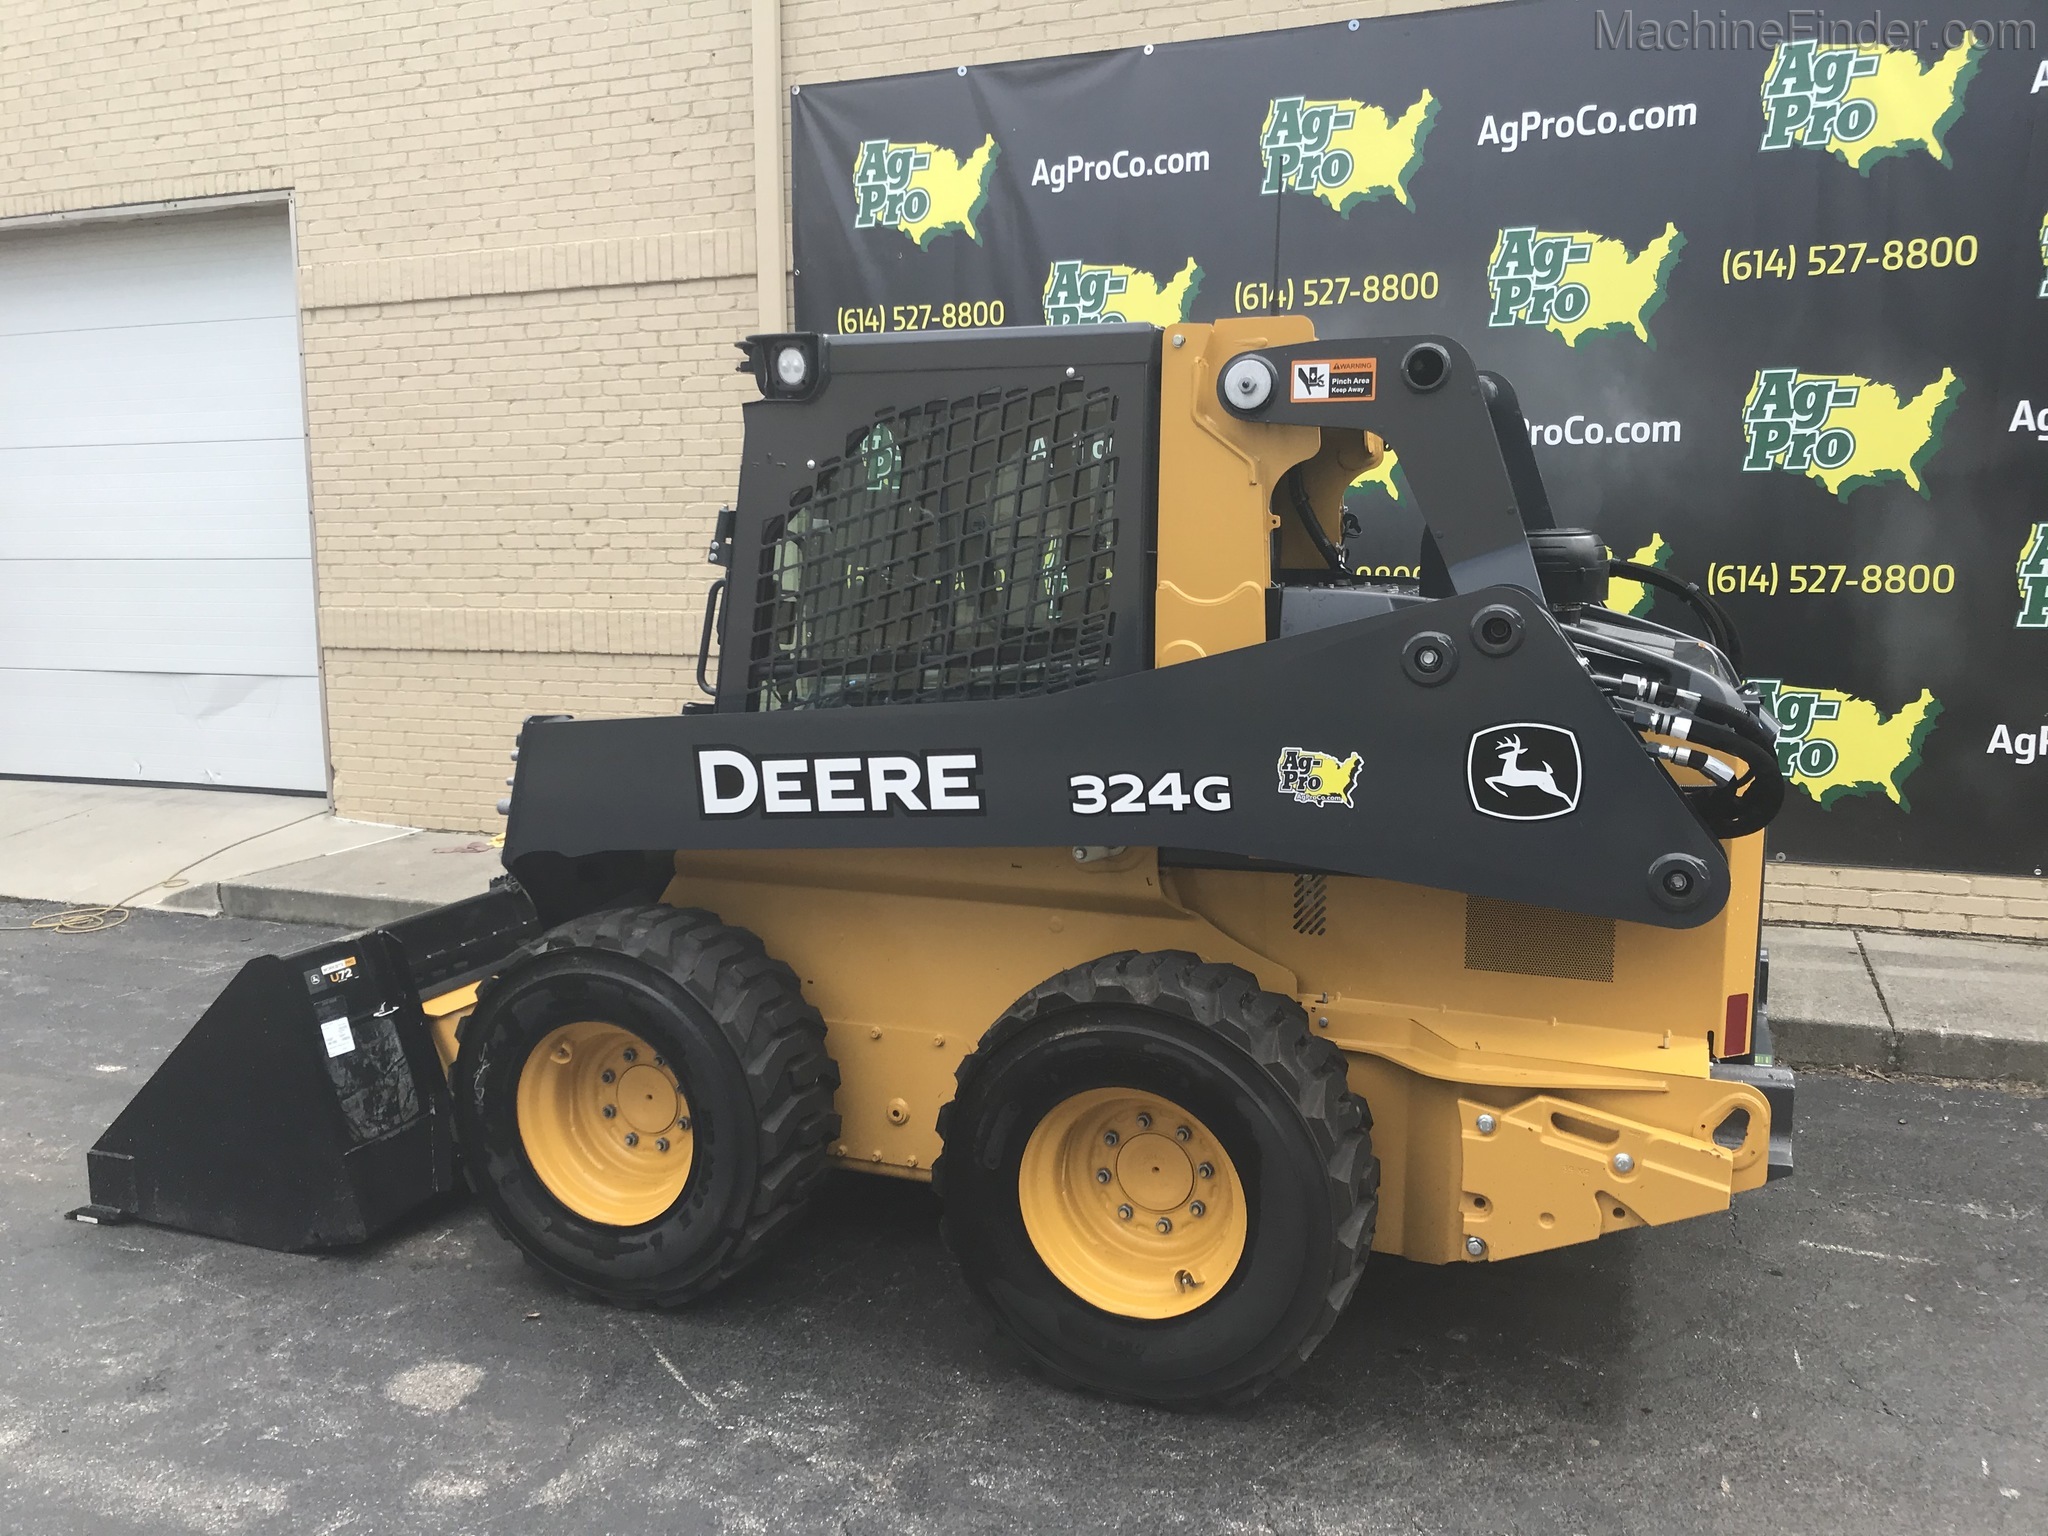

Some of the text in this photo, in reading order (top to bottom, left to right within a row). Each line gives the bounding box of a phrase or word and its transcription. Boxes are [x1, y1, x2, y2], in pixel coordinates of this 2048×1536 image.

[1765, 40, 1880, 101] Ag-
[1262, 97, 1354, 148] Ag-
[1477, 102, 1697, 152] AgProCo.com
[1761, 94, 1877, 150] Pro
[855, 138, 930, 190] Ag-
[1031, 150, 1210, 193] AgProCo.com
[1261, 145, 1353, 194] Pro
[854, 185, 930, 228] Pro
[1491, 227, 1592, 278] Ag-
[1723, 235, 1979, 284] (614) 527-8800
[1045, 260, 1127, 315] Ag-
[1234, 272, 1439, 313] (614) 527-8800
[1489, 276, 1589, 326] Pro
[837, 300, 1005, 335] (614) 527-8800
[1331, 377, 1370, 385] Pinch Area
[1339, 362, 1372, 370] WARNING
[1347, 386, 1365, 394] Away
[1745, 368, 1859, 427] Ag-
[1524, 415, 1681, 446] roCo.com
[1743, 421, 1856, 472] Pro
[1706, 562, 1956, 597] (614) 527-8800
[697, 749, 981, 815] DEERE
[1279, 770, 1323, 792] Pro
[1281, 749, 1323, 775] Ag-
[1070, 772, 1232, 815] 324G
[329, 967, 353, 983] U72
